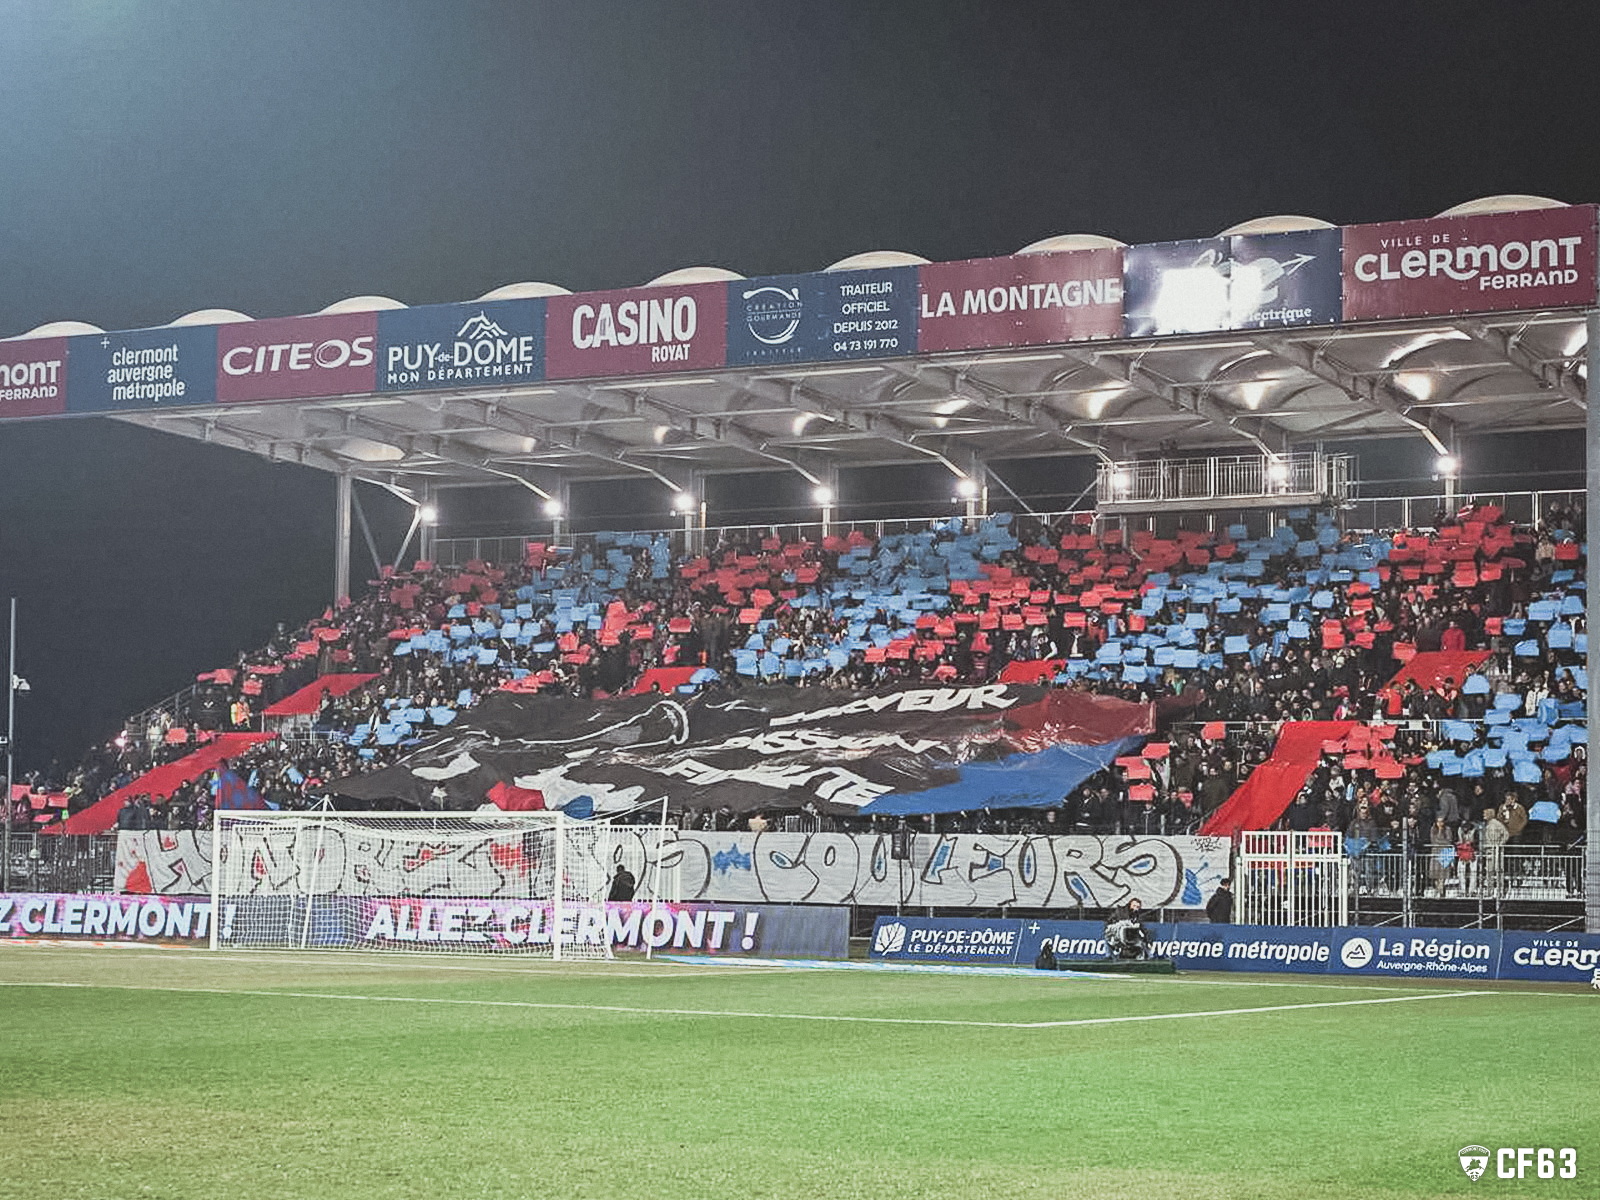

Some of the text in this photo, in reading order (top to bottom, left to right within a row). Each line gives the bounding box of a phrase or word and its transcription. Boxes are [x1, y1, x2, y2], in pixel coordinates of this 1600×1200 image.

[1381, 233, 1450, 249] VILLE DE
[839, 281, 893, 297] TRAITEUR
[921, 277, 1121, 319] LA MONTAGNE
[841, 300, 891, 315] OFFICIEL
[572, 295, 697, 350] CASINO
[833, 319, 899, 334] DEPUIS 2012
[112, 344, 179, 366] clermont
[651, 343, 691, 363] ROYAT
[833, 338, 898, 352] 04 73 191 770
[222, 336, 374, 376] CITEOS
[107, 364, 173, 383] auvergne
[387, 362, 533, 384] MON DÉPARTEMENT
[112, 380, 186, 402] métropole
[755, 832, 1184, 908] COULEURS
[19, 900, 212, 938] CLERMONT
[365, 902, 492, 942] ALLEZ
[499, 904, 735, 948] CLERMONT
[910, 928, 1016, 945] PUY-DE-DÔME
[1533, 939, 1579, 948] VILLE DE
[907, 943, 1013, 955] LE DÉPARTEMENT
[1227, 940, 1330, 965] métropole
[1378, 938, 1490, 962] La Région
[1376, 960, 1488, 974] Auvergne-Rhône-Alpes
